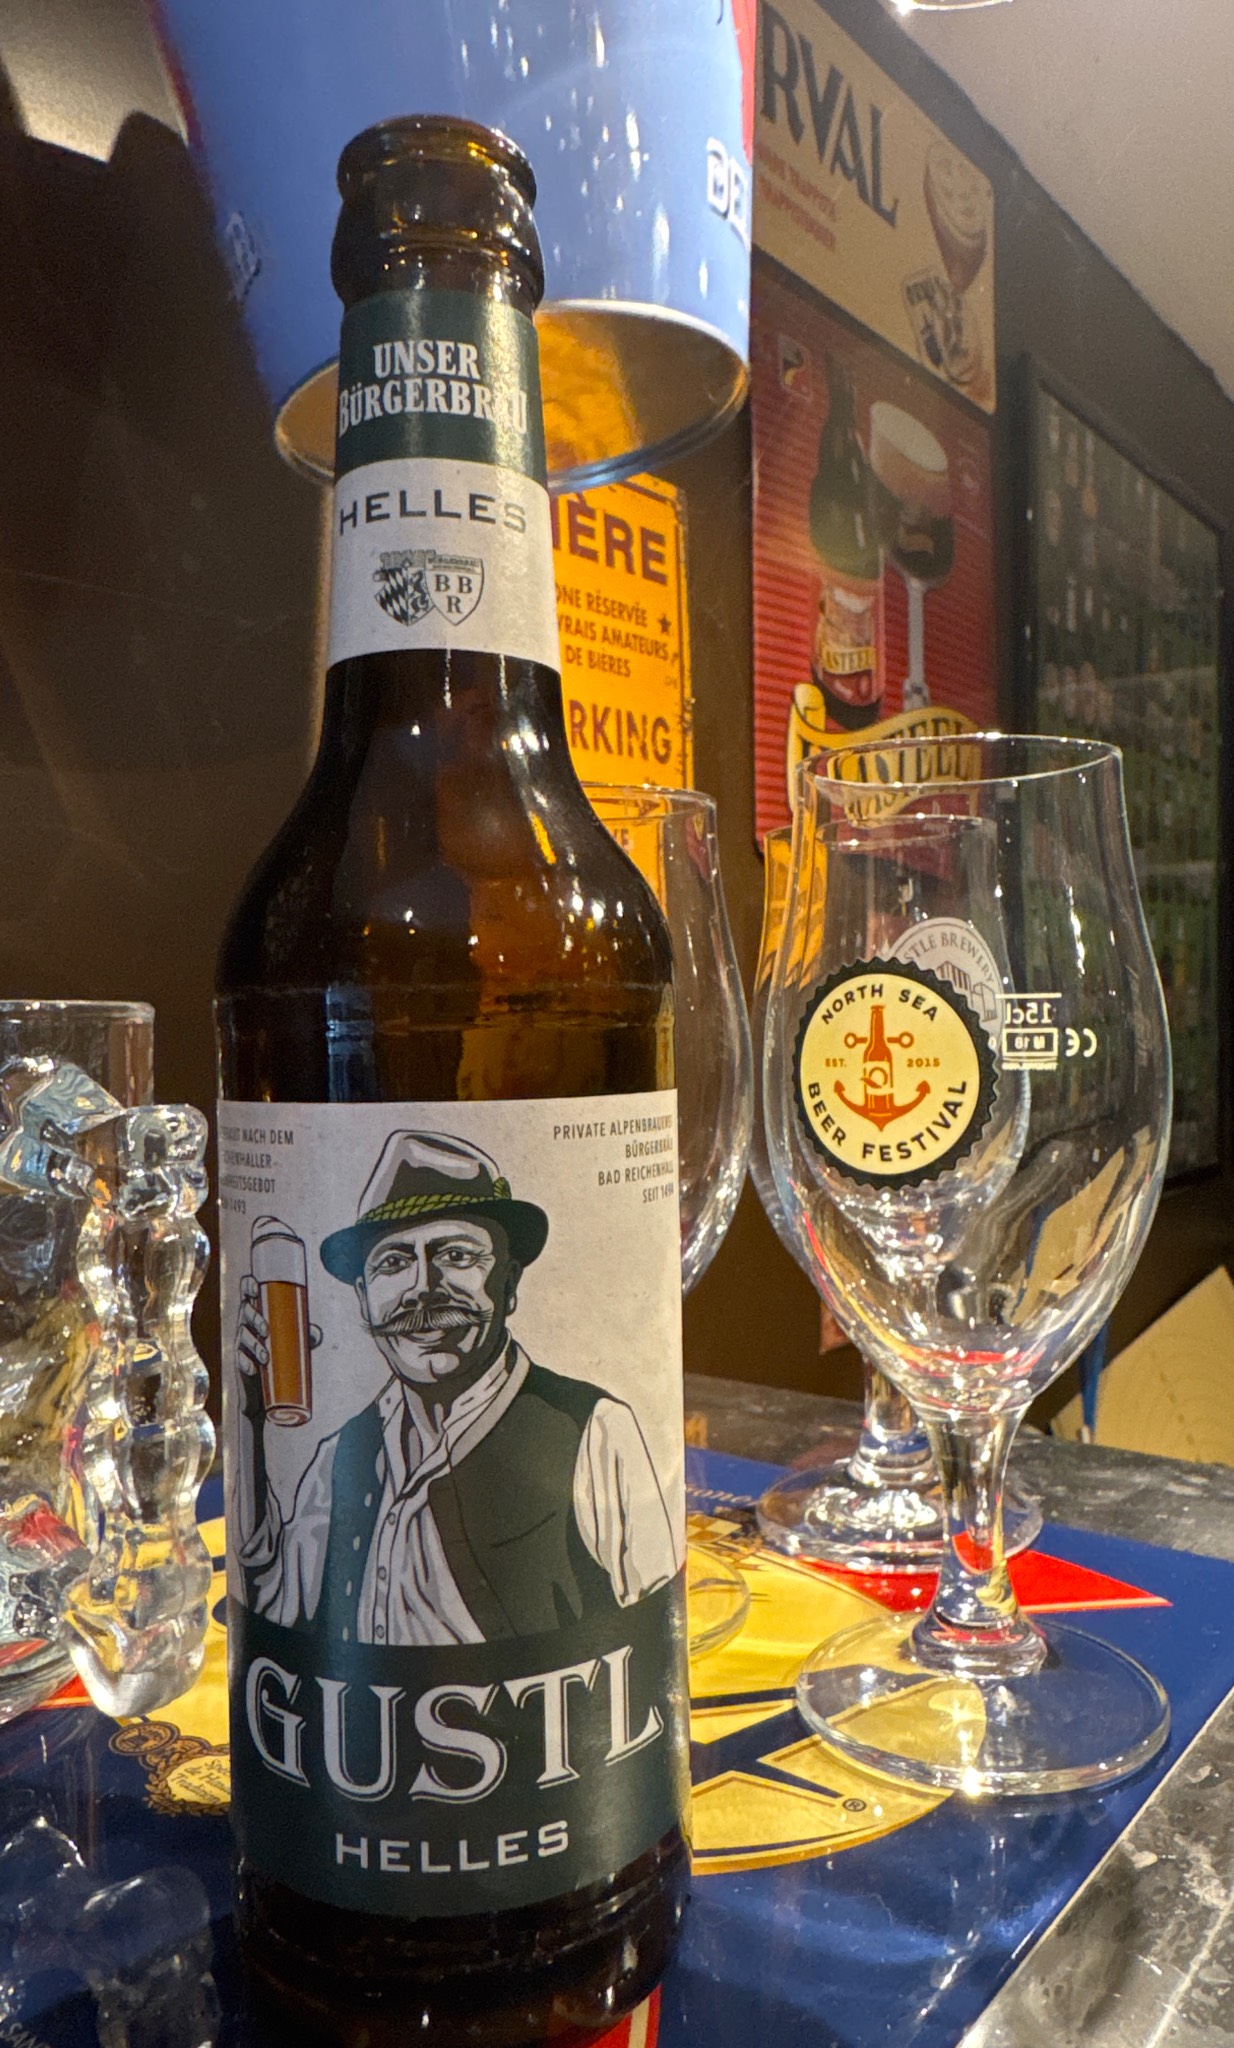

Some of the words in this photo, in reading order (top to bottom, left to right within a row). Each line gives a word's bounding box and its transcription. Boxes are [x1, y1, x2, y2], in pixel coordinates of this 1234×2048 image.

[373, 340, 481, 380] UNSER
[340, 489, 526, 536] HELLES
[586, 589, 648, 629] RÉSERVÉE
[565, 644, 583, 667] DE
[601, 626, 669, 660] AMATEURS
[821, 984, 884, 1025] NORTH
[898, 989, 938, 1022] SEA
[907, 1057, 941, 1068] 2015
[242, 1128, 266, 1145] NACH
[270, 1129, 294, 1146] DEM
[553, 1122, 606, 1140] PRIVATE
[808, 1082, 847, 1147] BEER
[862, 1081, 967, 1162] FESTIVAL
[598, 1169, 621, 1187] BAD
[643, 1186, 660, 1204] SEIT
[245, 1644, 665, 1804] GUSTL
[335, 1820, 569, 1874] HELLES
